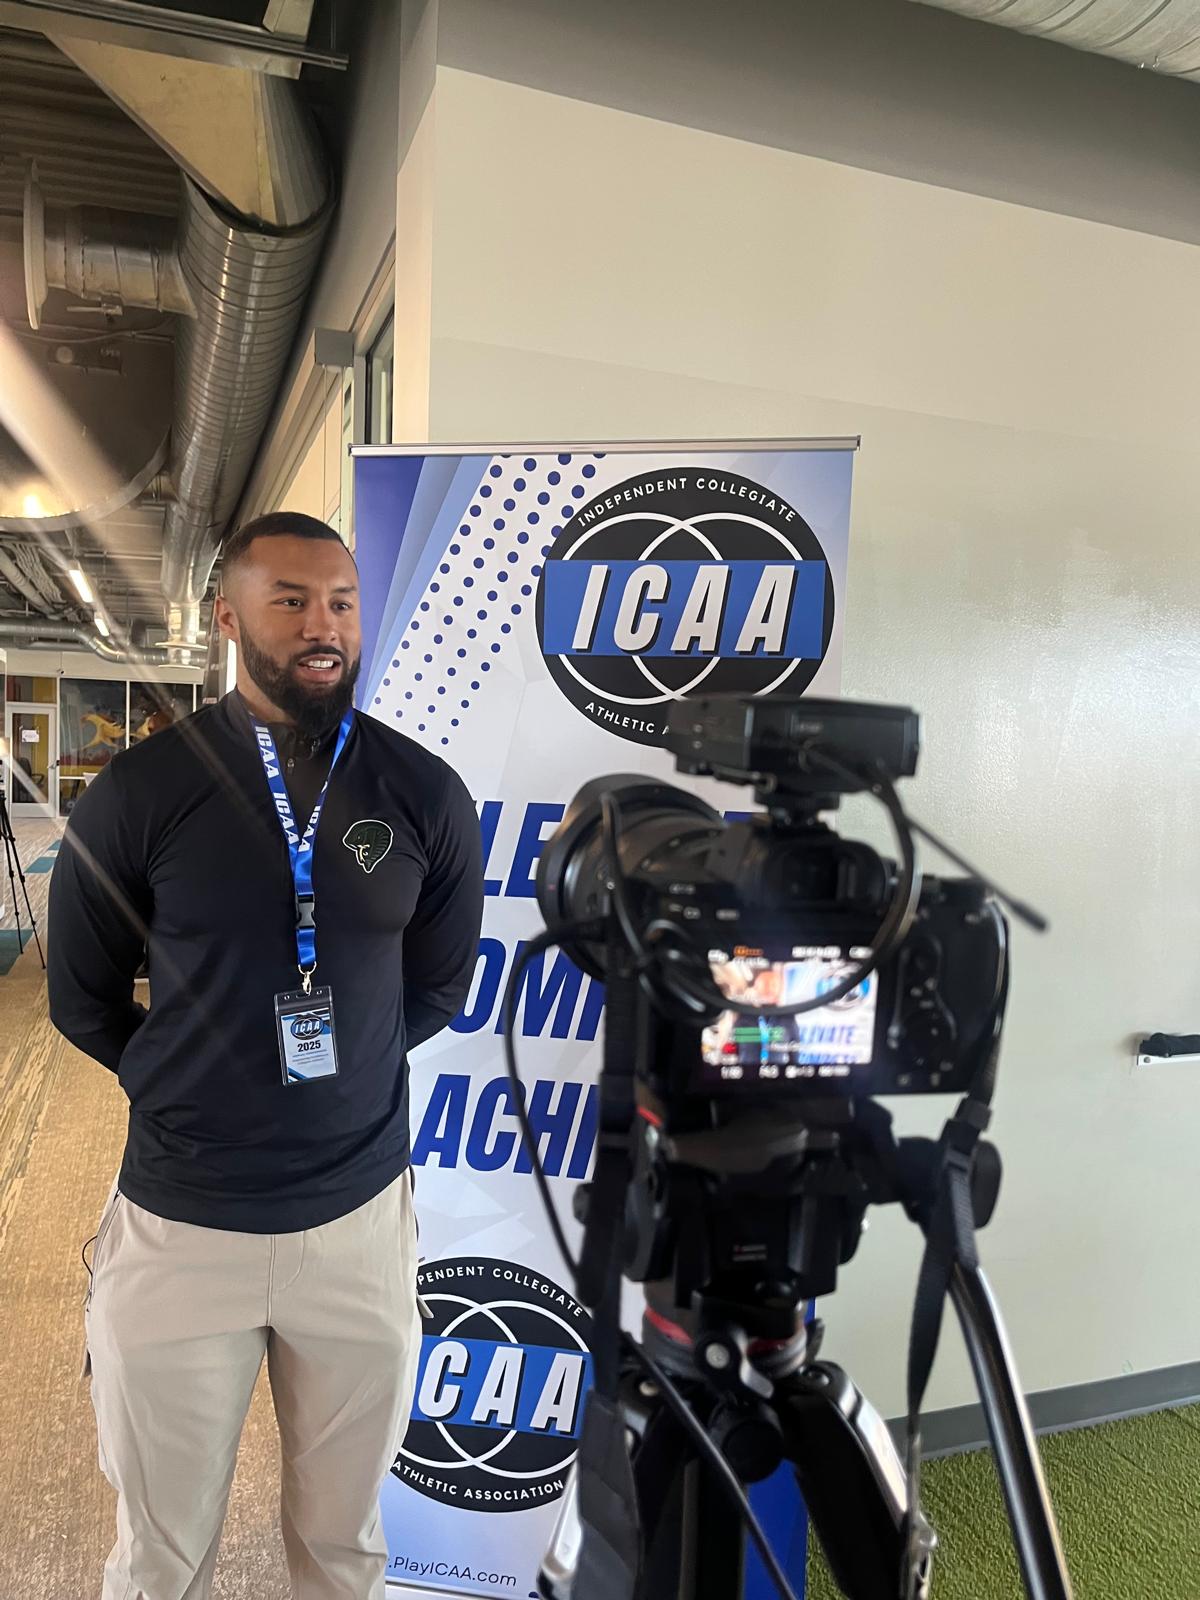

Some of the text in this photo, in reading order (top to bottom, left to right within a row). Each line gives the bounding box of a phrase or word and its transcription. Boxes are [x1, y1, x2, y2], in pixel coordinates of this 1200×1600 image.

[577, 477, 797, 528] INDEPENDENT COLLEGIATE
[571, 564, 798, 655] ICAA
[584, 702, 655, 734] ATHLETIC
[254, 726, 300, 845] ICAA ICAA
[298, 805, 321, 852] ICAA
[294, 1020, 320, 1034] ICAA
[297, 1040, 321, 1052] 2025
[417, 1266, 583, 1318] PENDENT COLLEGIATE
[417, 1340, 585, 1434] CAA
[392, 1461, 564, 1500] ATHLETIC ASSOCIATION
[388, 1556, 517, 1587] .PlayICAA.com
